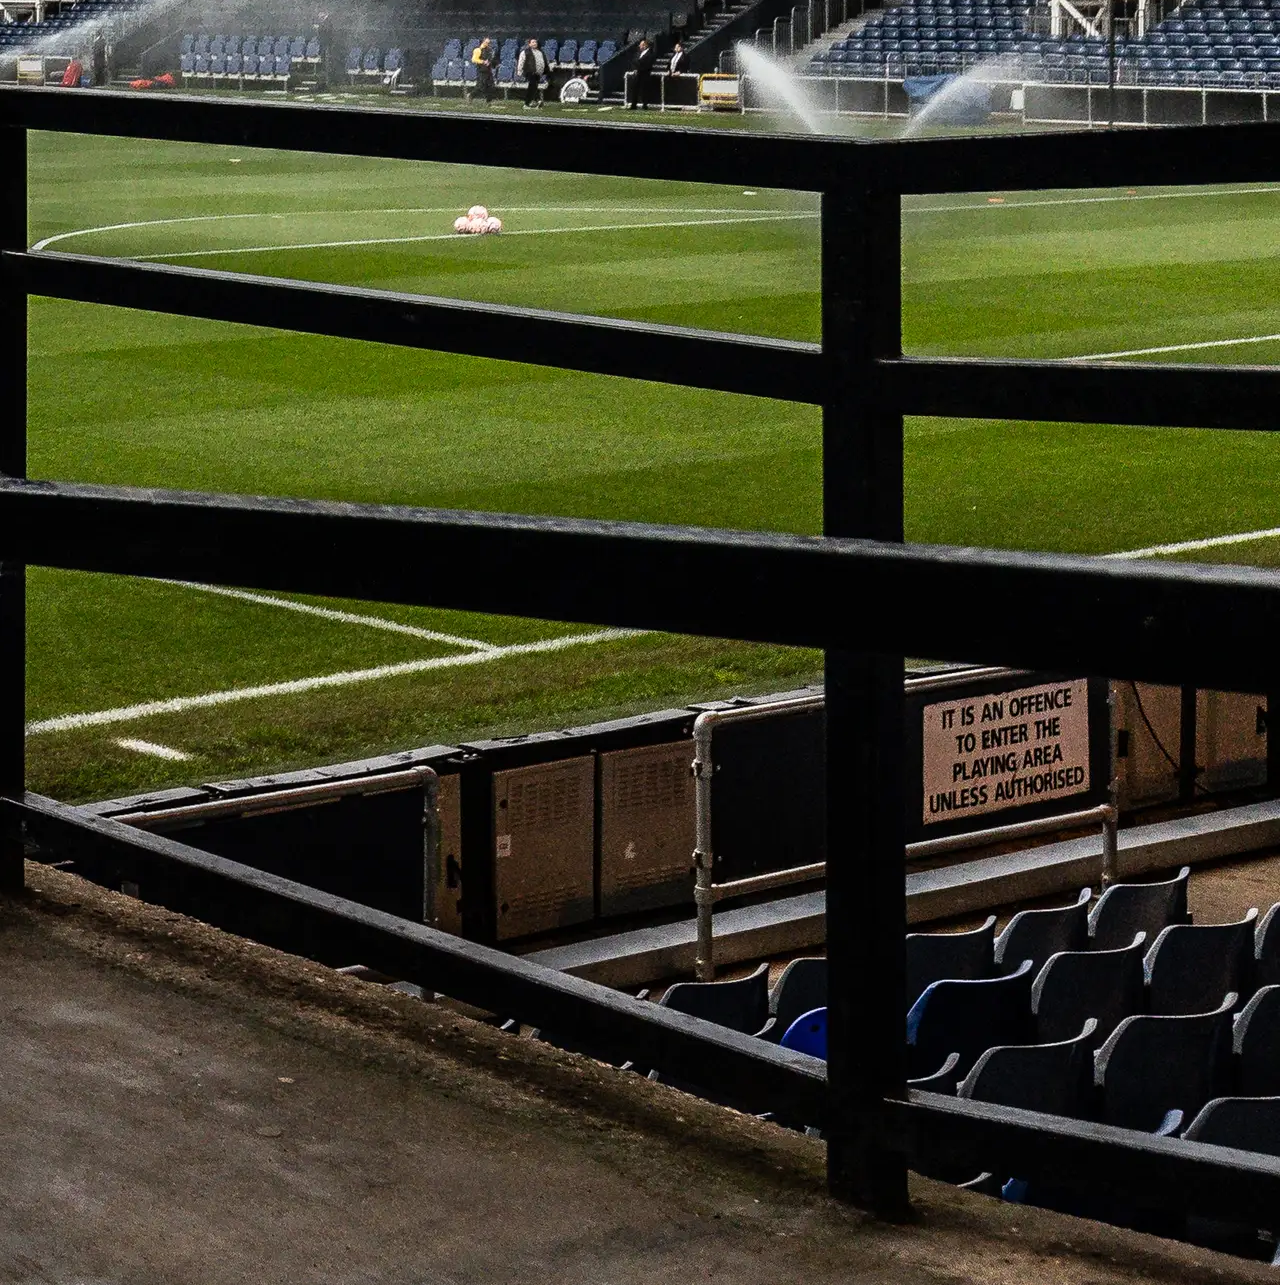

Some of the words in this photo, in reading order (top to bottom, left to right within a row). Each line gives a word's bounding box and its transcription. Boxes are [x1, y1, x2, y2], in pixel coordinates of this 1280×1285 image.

[942, 706, 954, 730] IT
[960, 702, 975, 726] IS
[980, 699, 1004, 723] AN
[1009, 687, 1073, 718] OFFENCE
[955, 733, 976, 754] TO
[981, 725, 1028, 751] ENTER
[1035, 717, 1061, 740] THE
[953, 752, 1017, 783] PLAYING
[1022, 742, 1064, 770] AREA
[929, 787, 989, 815] UNLESS
[993, 765, 1086, 802] AUTHORISED
